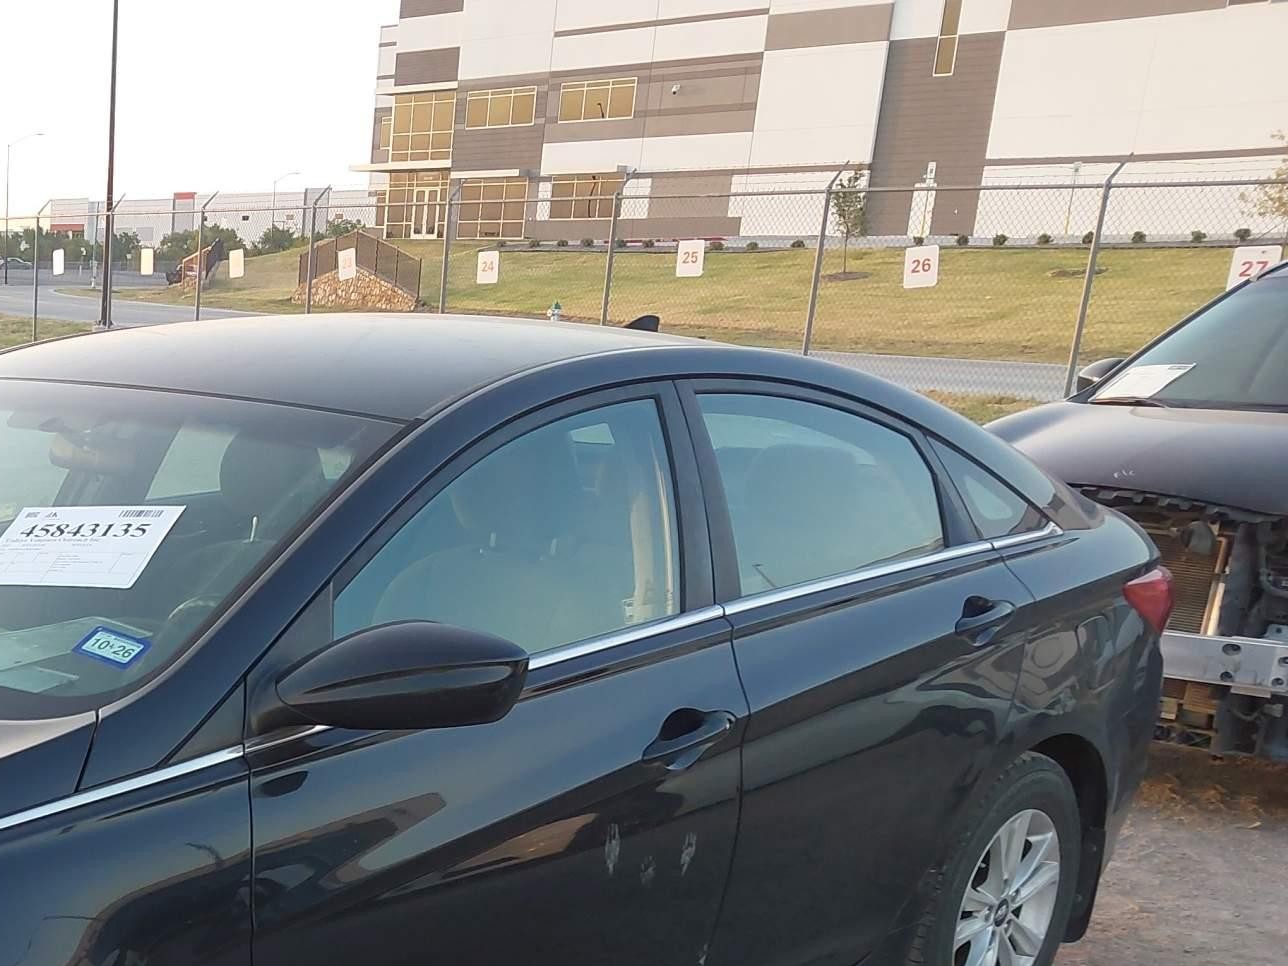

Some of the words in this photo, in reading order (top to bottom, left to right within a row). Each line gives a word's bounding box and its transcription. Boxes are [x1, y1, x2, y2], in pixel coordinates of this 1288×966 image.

[682, 251, 698, 264] 25
[482, 261, 494, 272] 24
[911, 258, 931, 273] 26
[1239, 261, 1269, 277] 27
[20, 523, 152, 538] 45843135
